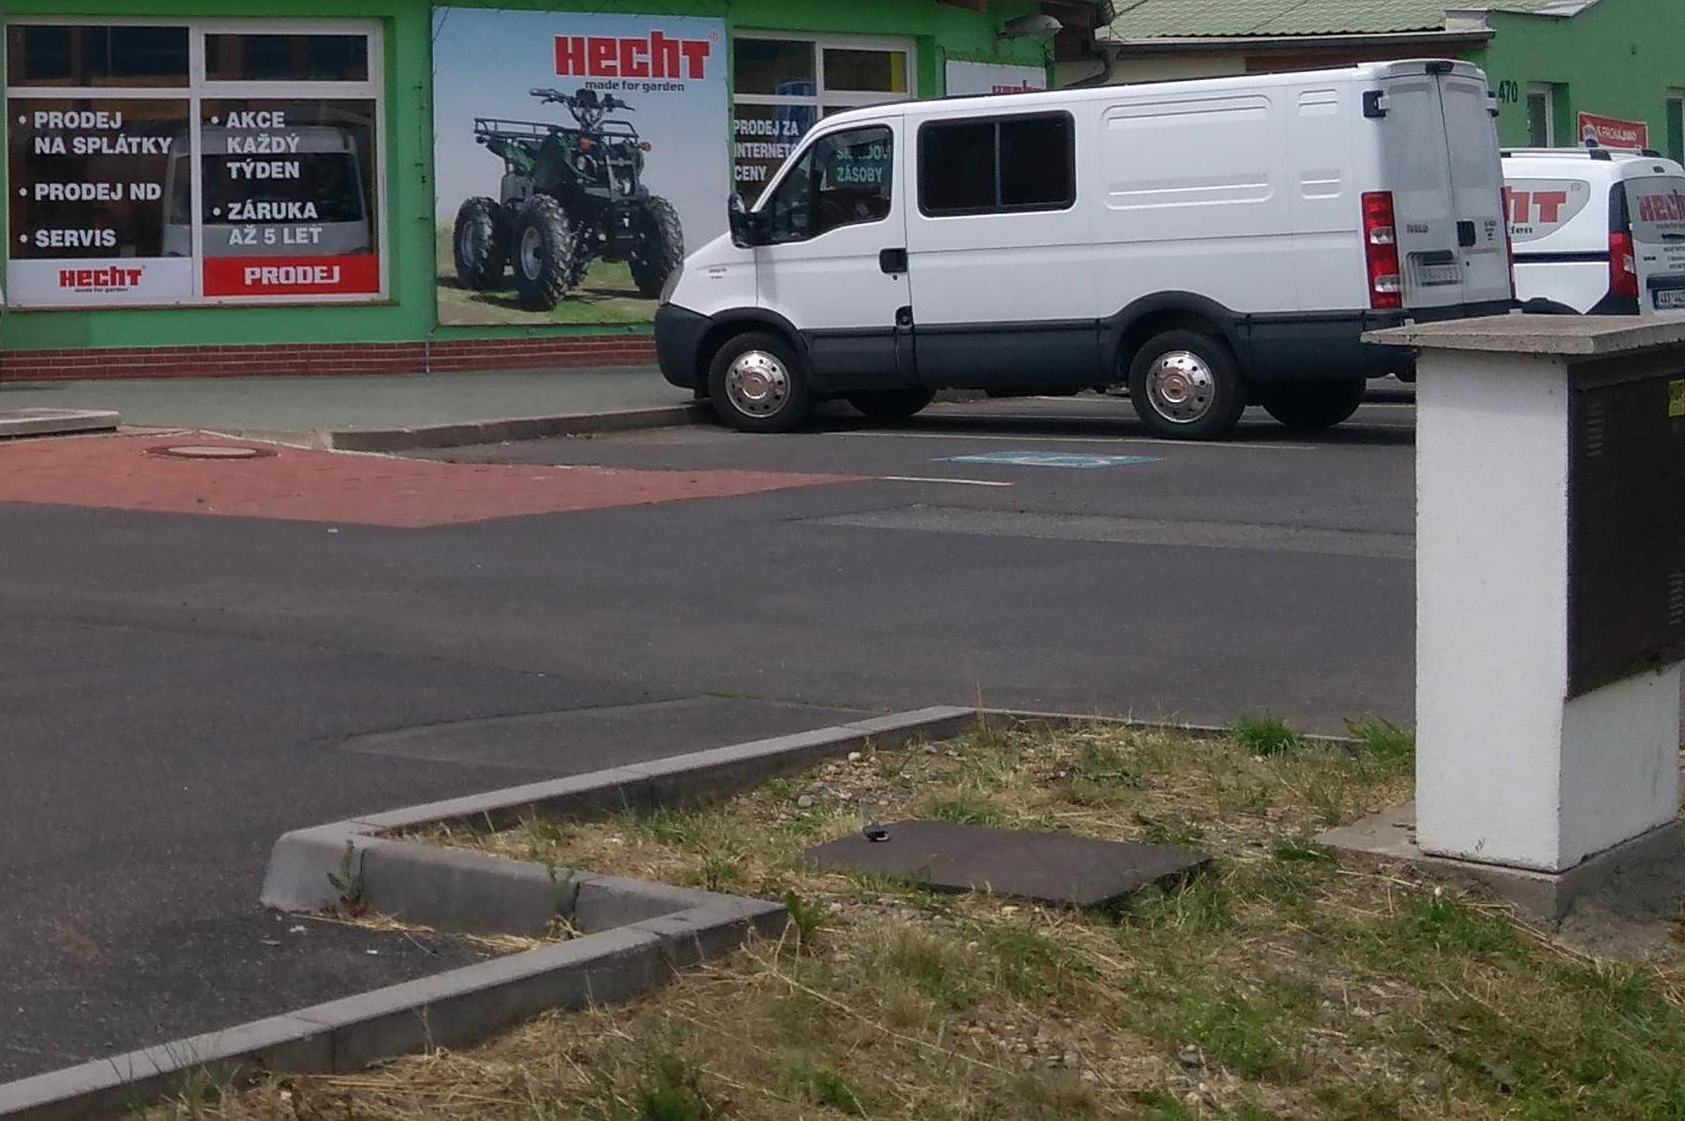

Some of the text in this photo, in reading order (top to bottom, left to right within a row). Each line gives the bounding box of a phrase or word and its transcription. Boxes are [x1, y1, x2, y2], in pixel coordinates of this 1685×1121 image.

[584, 79, 685, 93] made for garden
[34, 111, 123, 129] PRODEJ
[226, 111, 286, 129] AKCE
[782, 120, 799, 136] ZA
[34, 133, 173, 154] NA SPLÁTKY
[226, 132, 301, 154] KAŽDÝ
[226, 158, 301, 179] TÝDEN
[734, 165, 767, 181] CENY
[34, 182, 163, 201] PRODEJ ND
[227, 199, 318, 220] ZÁRUKA
[35, 229, 117, 248] SERVIS
[228, 224, 323, 245] AŽ 5 LET
[244, 265, 341, 285] PRODEJ
